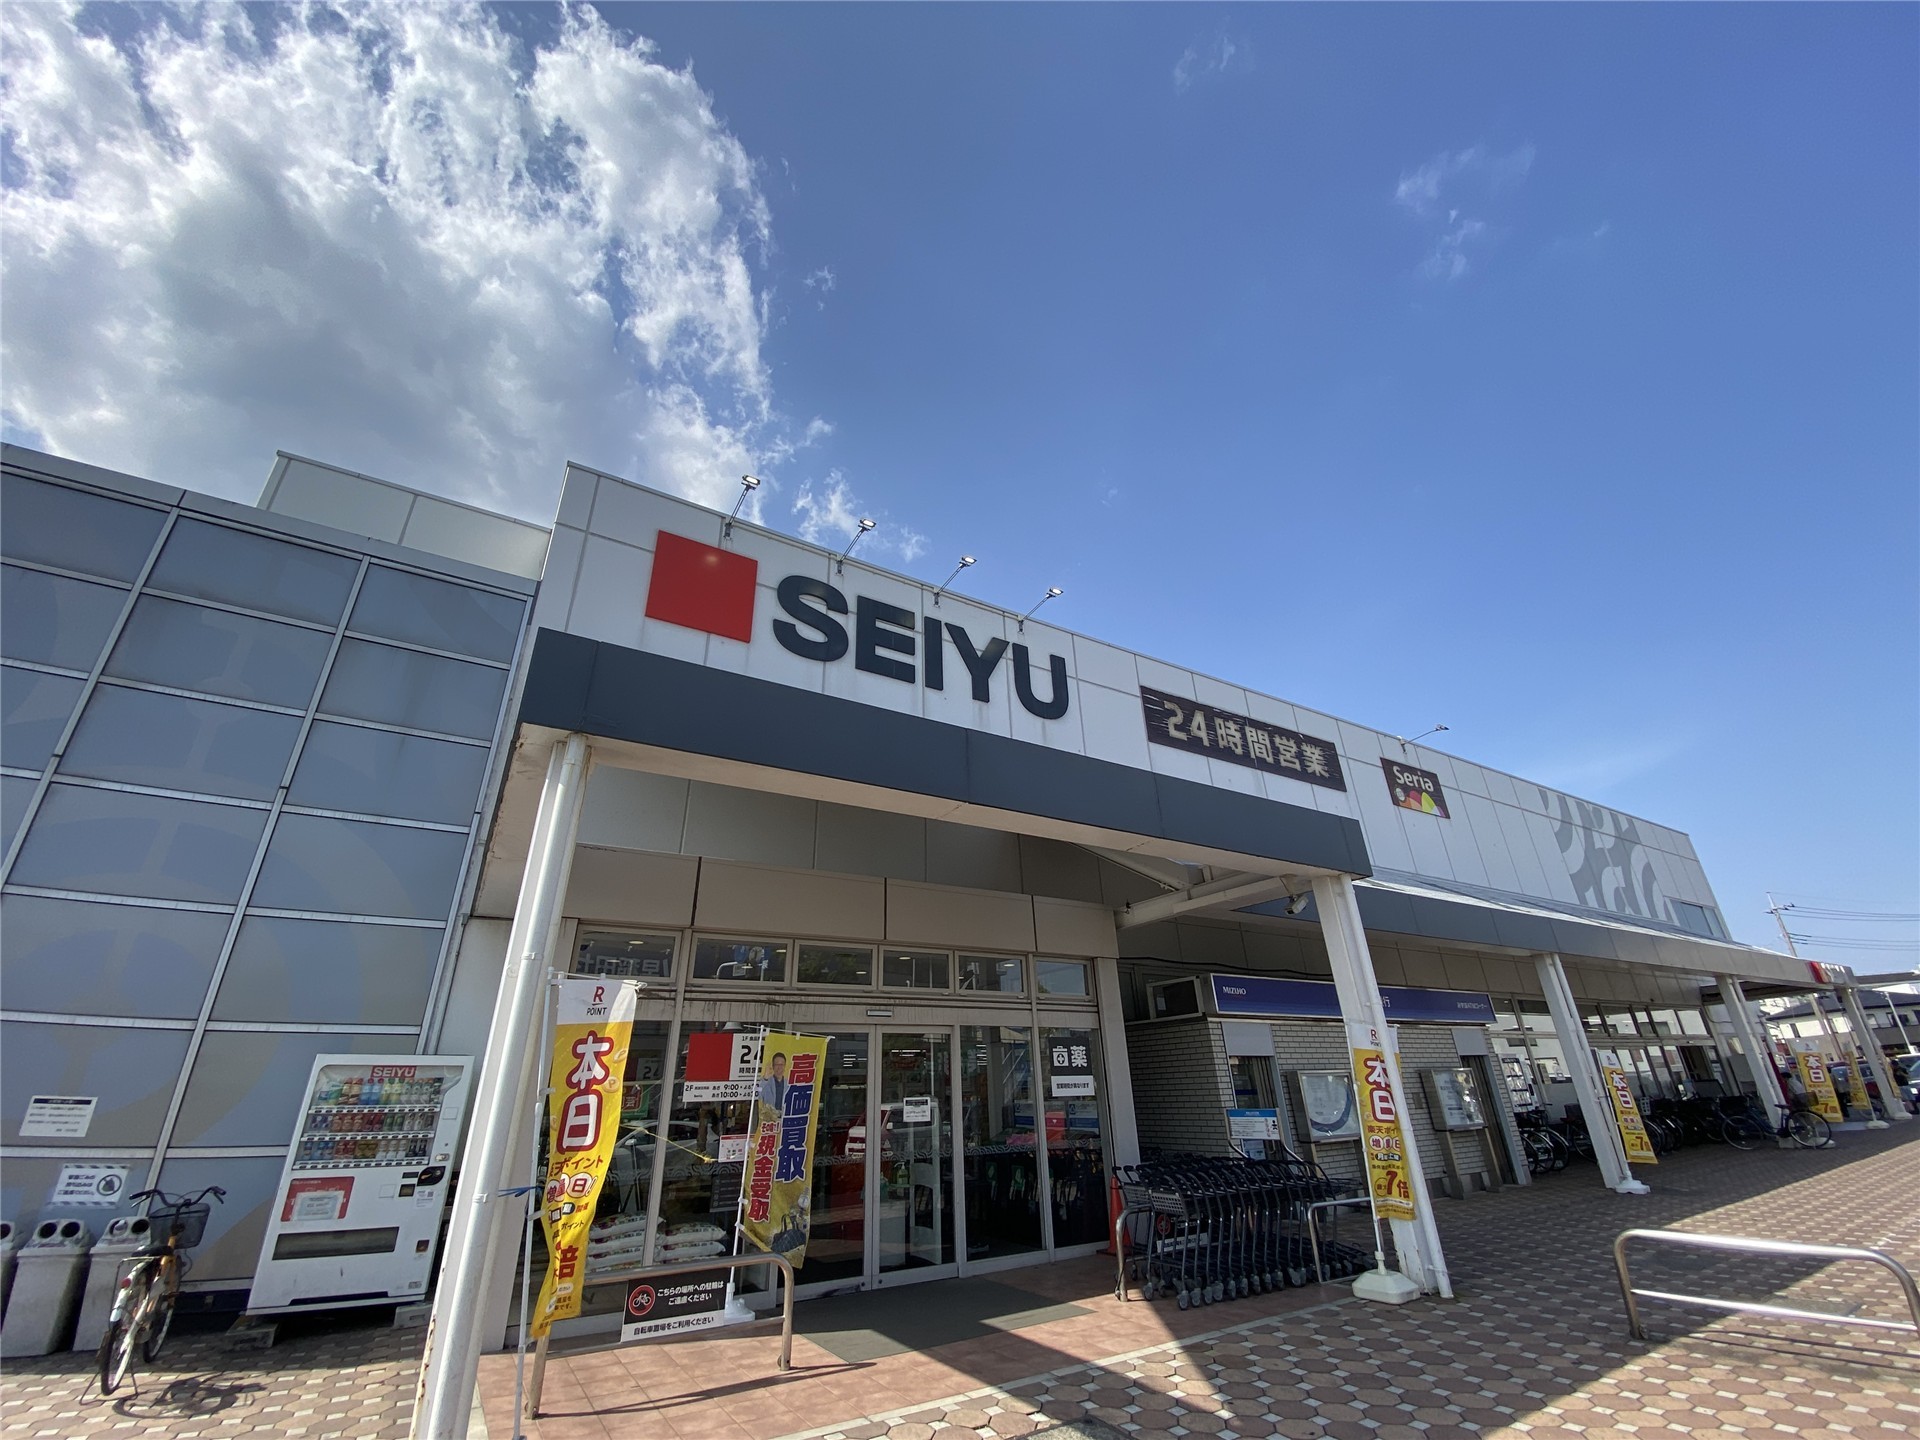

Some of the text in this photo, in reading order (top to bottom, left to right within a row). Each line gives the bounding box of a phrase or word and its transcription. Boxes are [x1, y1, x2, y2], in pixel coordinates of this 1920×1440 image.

[773, 575, 1069, 720] SEIYU
[1163, 701, 1330, 779] 24時間営業
[1392, 765, 1434, 792] Seria
[1222, 986, 1247, 995] MIZUHO
[586, 1007, 607, 1016] POINT
[740, 1045, 765, 1064] 24
[1070, 1045, 1088, 1067] 薬
[372, 1066, 415, 1078] SEIYU
[560, 1032, 613, 1152] 本日
[774, 1053, 818, 1183] 高価買取
[748, 1134, 776, 1222] 現金受取
[657, 1281, 724, 1297] こちらの場所への駐輪は
[633, 1316, 714, 1336] 自転車置場をご利用ください
